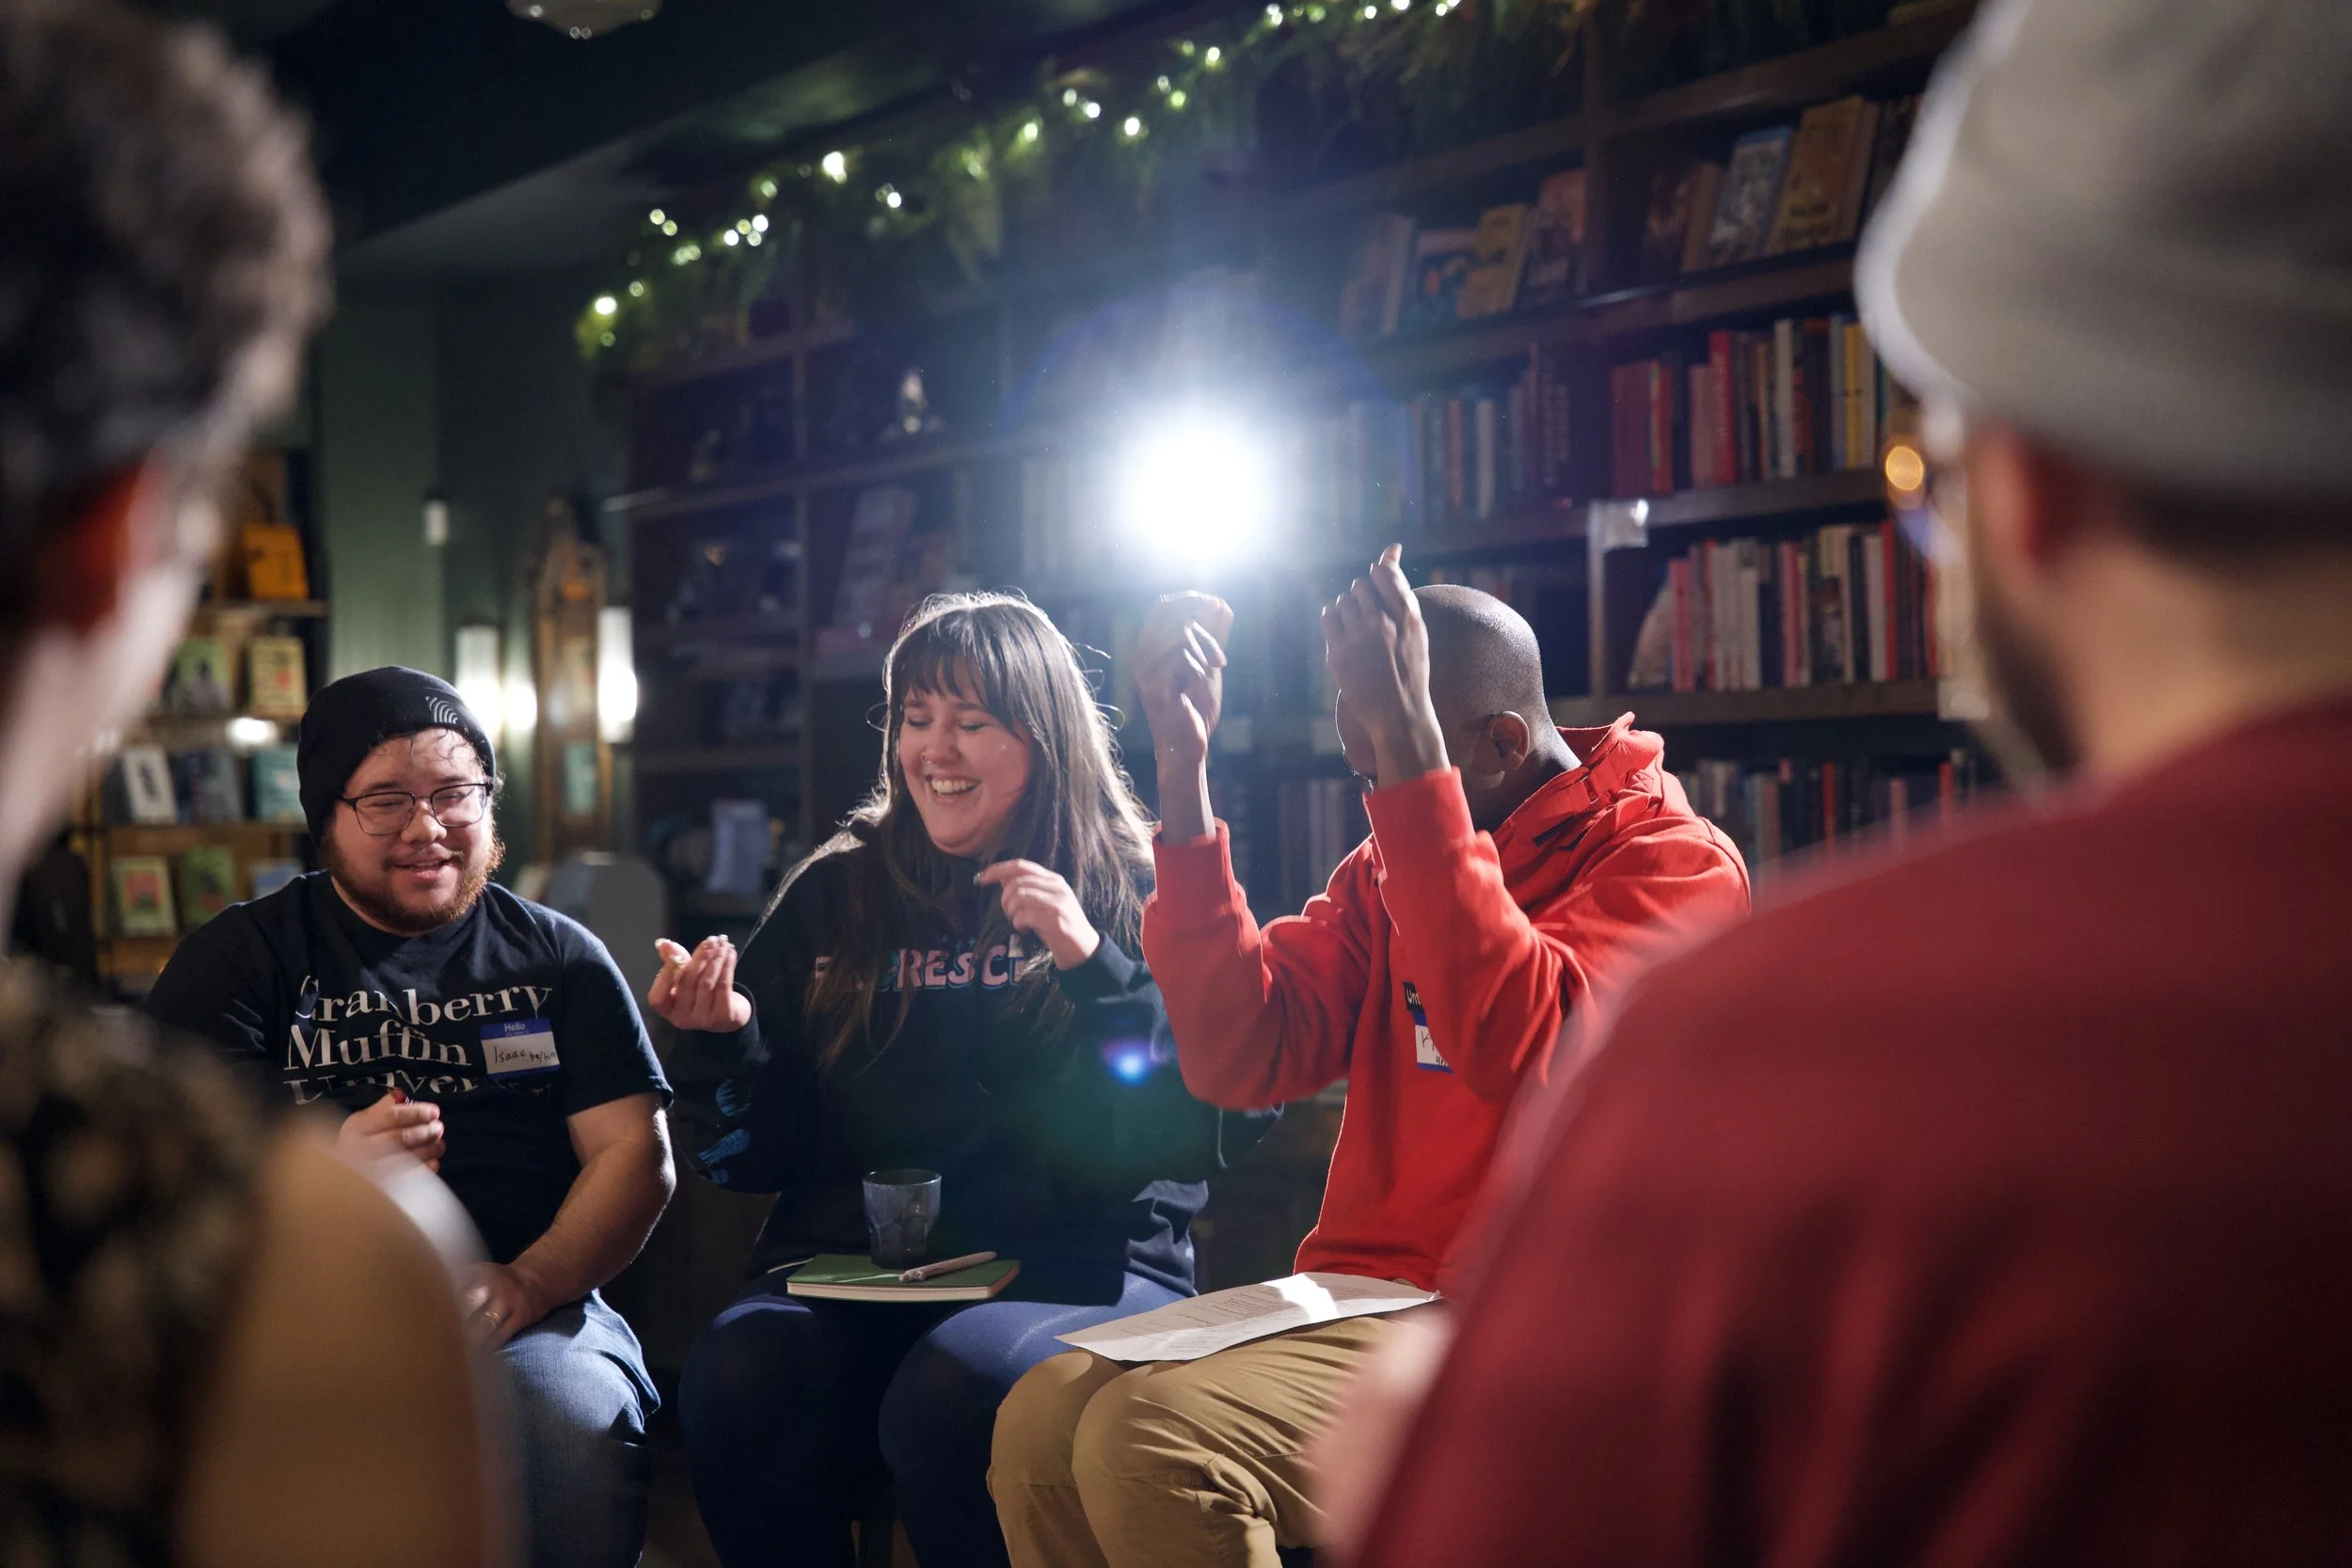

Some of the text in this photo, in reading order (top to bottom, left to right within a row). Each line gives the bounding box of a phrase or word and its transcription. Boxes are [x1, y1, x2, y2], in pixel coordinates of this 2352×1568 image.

[504, 1022, 526, 1033] Hello
[283, 1019, 472, 1070] Muffin
[494, 1045, 527, 1064] Isaac
